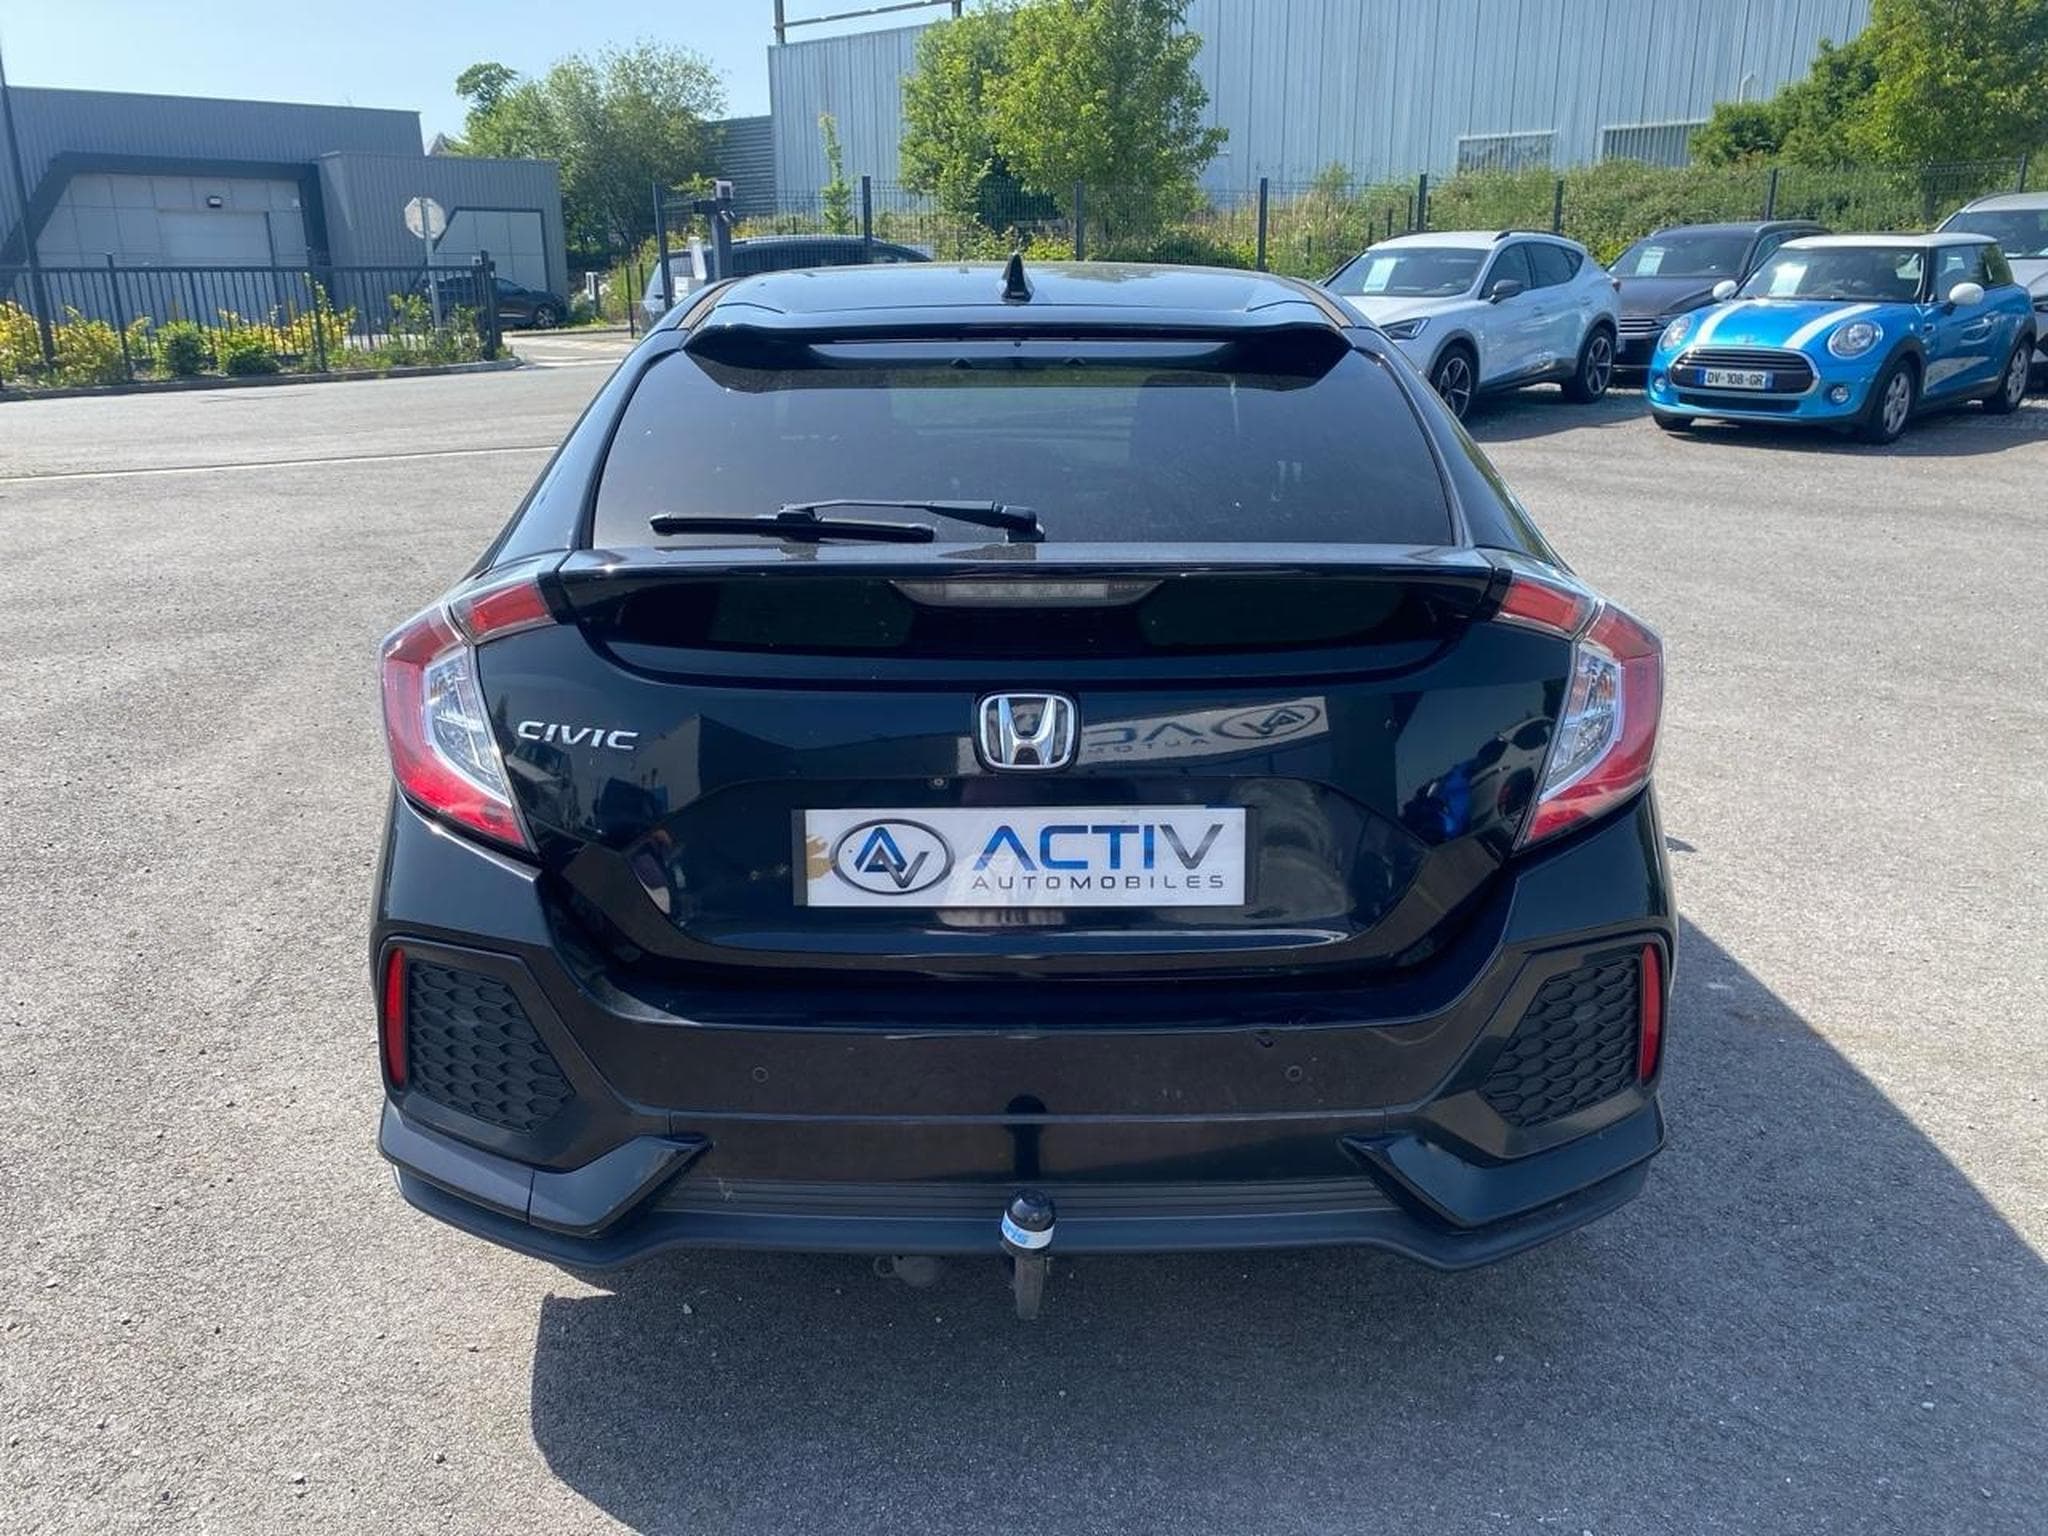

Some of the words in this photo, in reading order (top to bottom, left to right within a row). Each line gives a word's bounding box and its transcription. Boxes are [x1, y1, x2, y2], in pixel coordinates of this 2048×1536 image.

[518, 720, 640, 750] CIVIC
[972, 824, 1224, 871] ACTIV
[972, 875, 1224, 890] AUTOMOBILES
